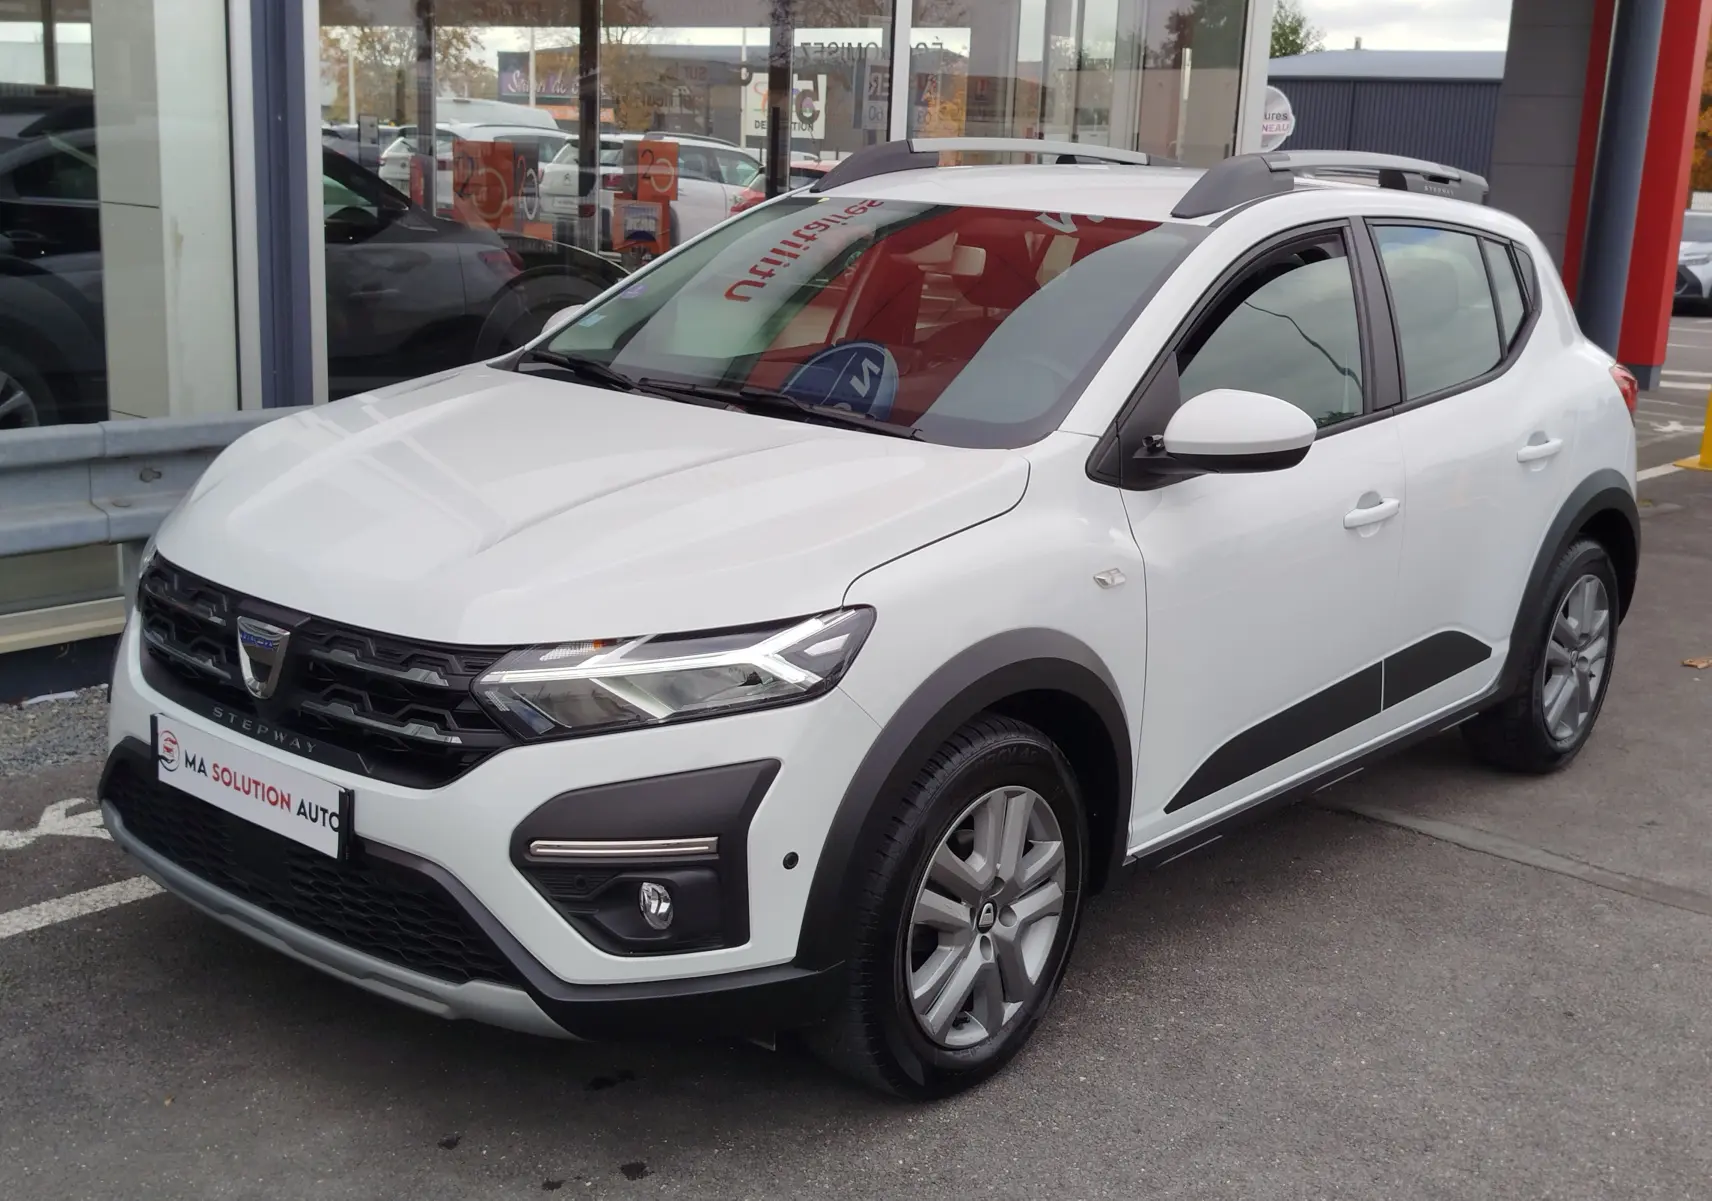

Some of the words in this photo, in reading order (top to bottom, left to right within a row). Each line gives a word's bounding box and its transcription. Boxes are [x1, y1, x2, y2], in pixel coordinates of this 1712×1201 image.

[212, 706, 317, 753] STEPWAY
[184, 749, 208, 778] MA
[211, 763, 292, 813] SOLUTION
[296, 798, 340, 832] AUTO
